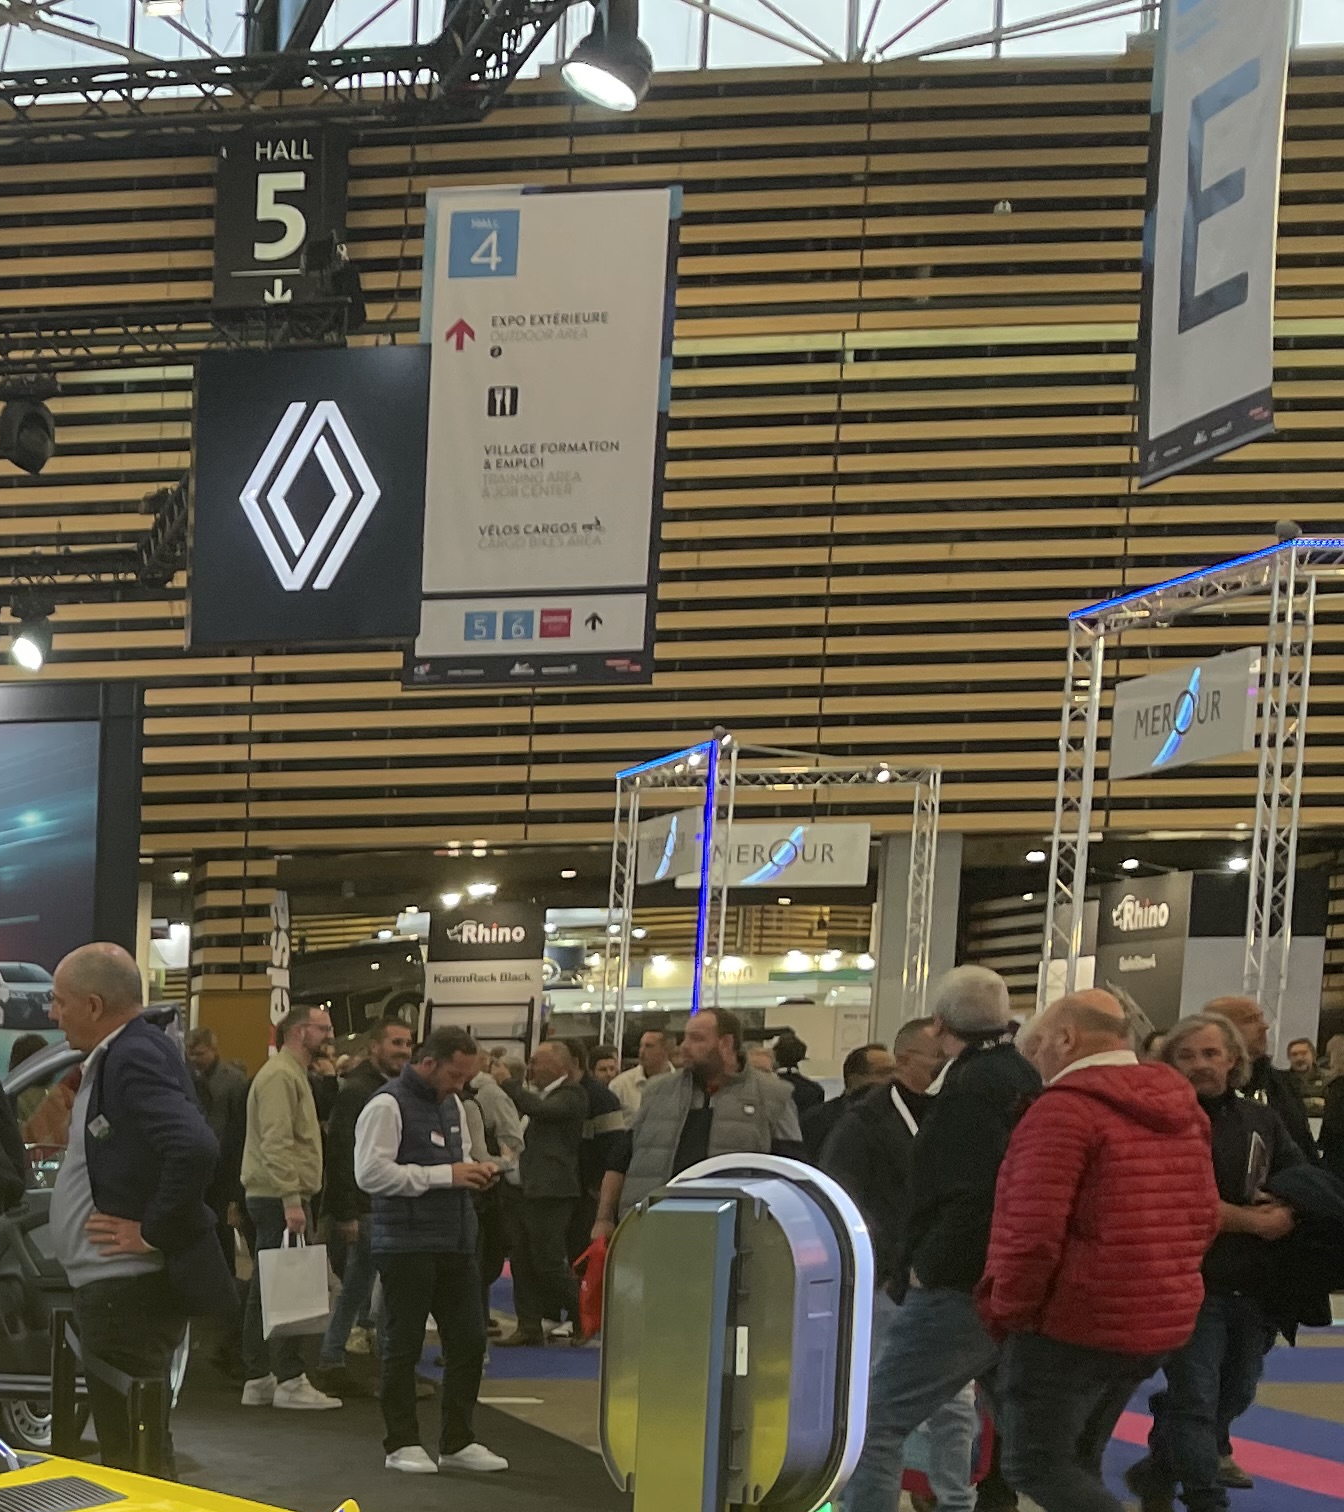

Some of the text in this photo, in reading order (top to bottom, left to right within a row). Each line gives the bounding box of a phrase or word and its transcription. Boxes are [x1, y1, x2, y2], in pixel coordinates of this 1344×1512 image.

[255, 138, 314, 161] HALL
[254, 171, 307, 261] 5
[470, 230, 503, 271] 4
[491, 315, 526, 328] EXPO
[484, 440, 620, 456] VILLAGE FORMATION
[495, 457, 544, 469] EMPLOI
[523, 522, 578, 535] CARGOS
[472, 617, 487, 639] 5
[511, 616, 525, 638] 6
[1122, 898, 1169, 931] Rhino
[461, 921, 526, 944] Rhino
[500, 971, 531, 982] Black
